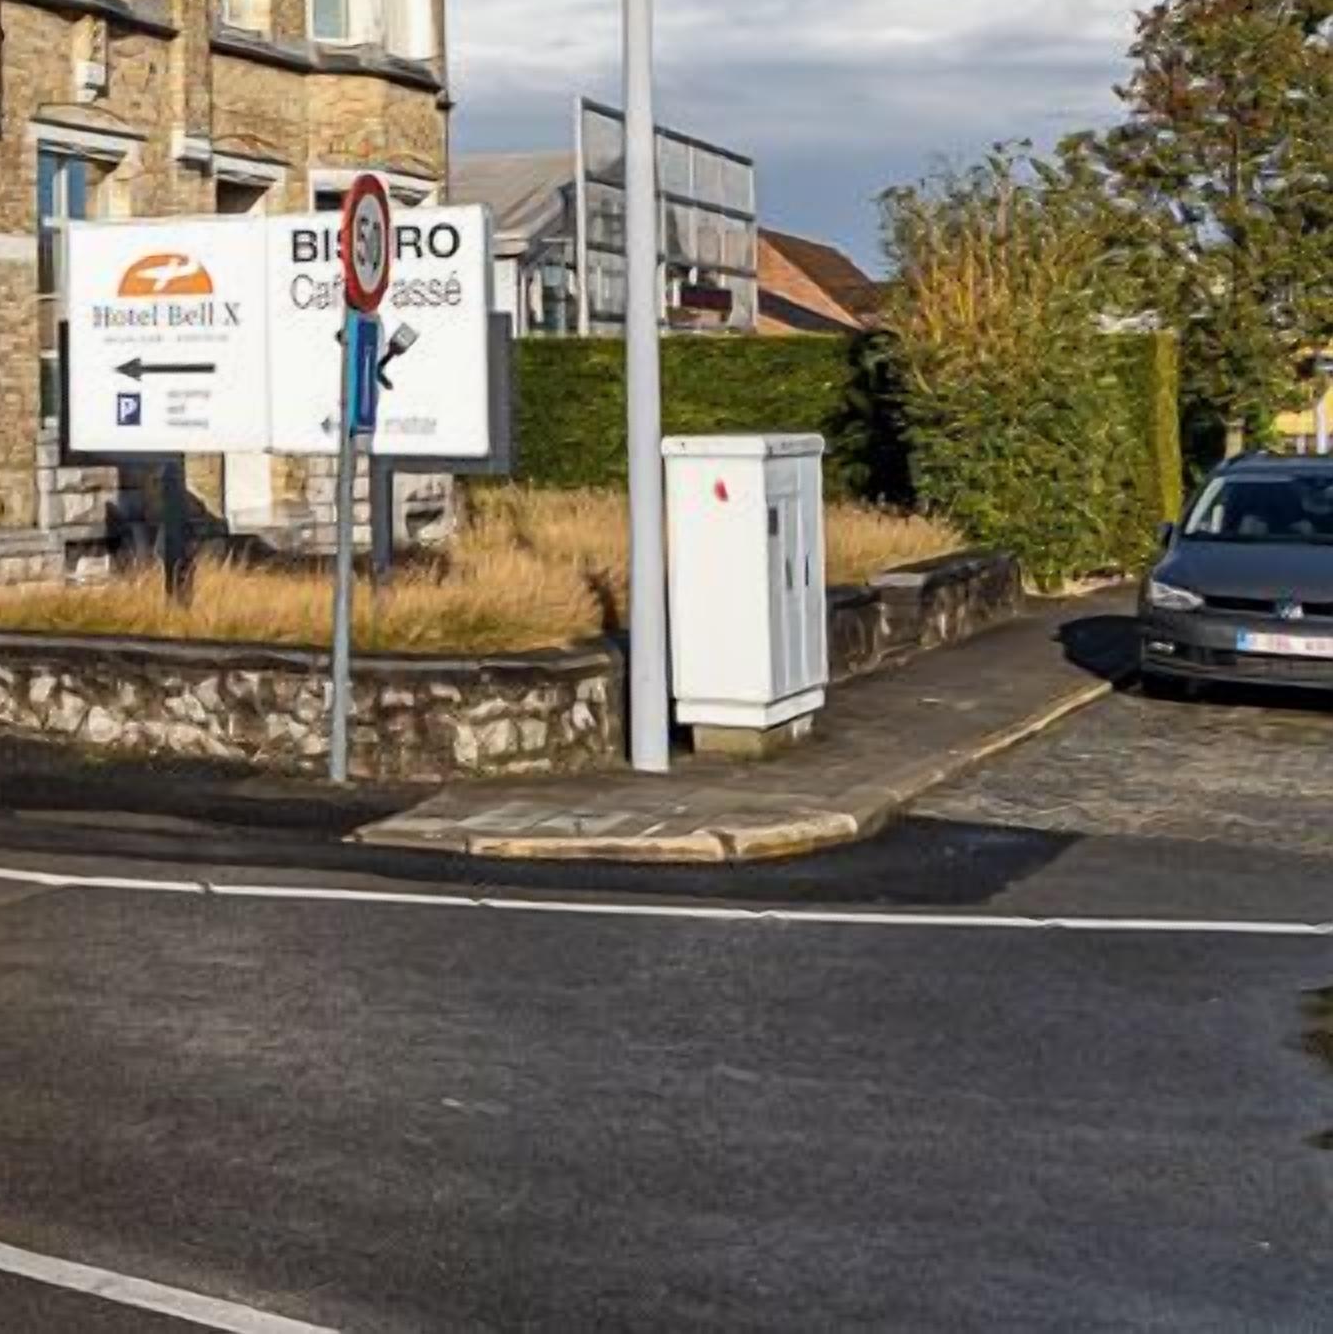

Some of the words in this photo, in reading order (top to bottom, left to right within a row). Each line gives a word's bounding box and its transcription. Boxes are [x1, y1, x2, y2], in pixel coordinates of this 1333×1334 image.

[291, 222, 460, 262] BIRO
[390, 270, 461, 309] assé
[93, 304, 158, 328] Hotel
[168, 302, 214, 327] Bell
[224, 302, 241, 327] X
